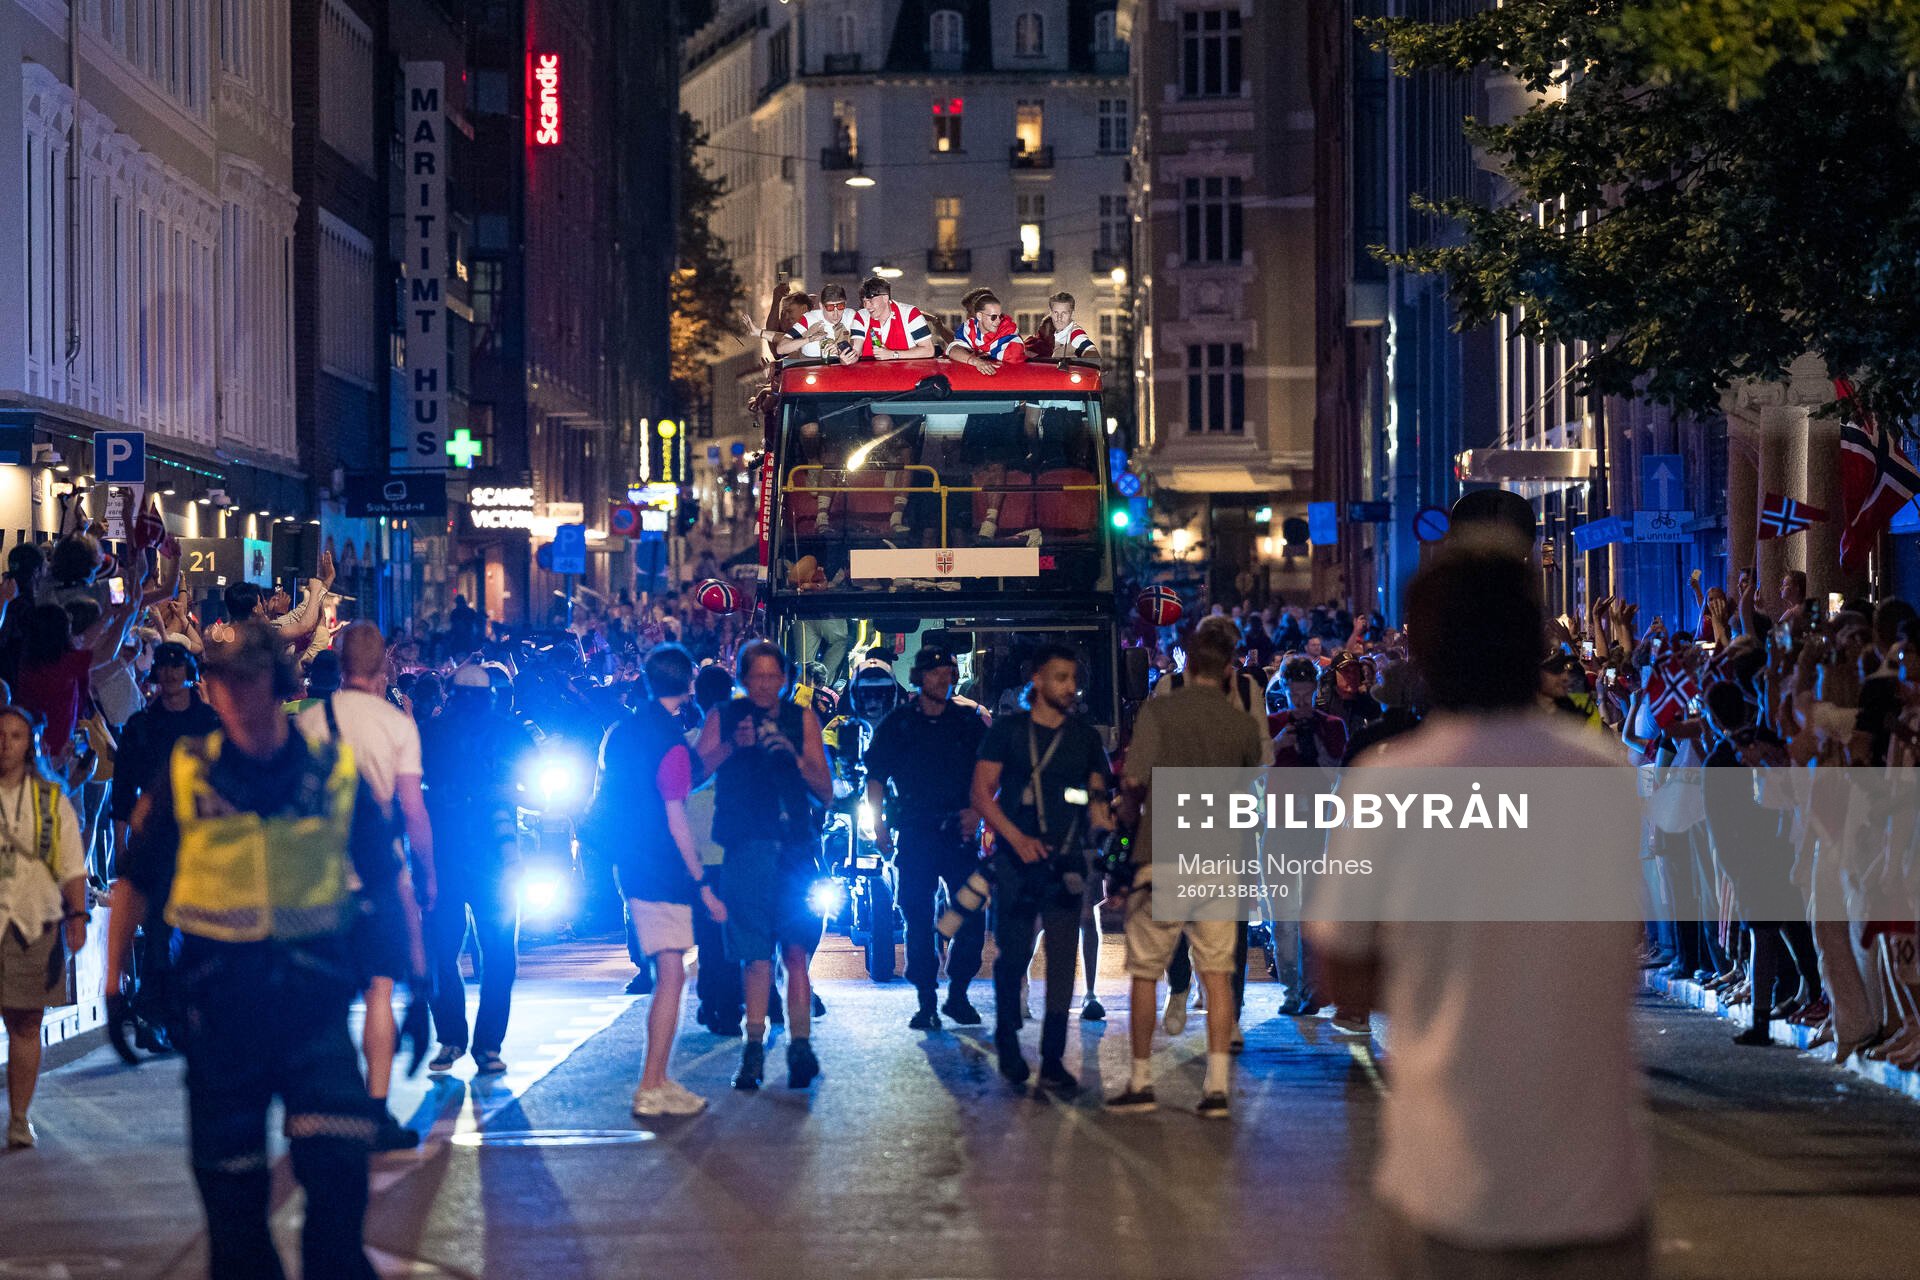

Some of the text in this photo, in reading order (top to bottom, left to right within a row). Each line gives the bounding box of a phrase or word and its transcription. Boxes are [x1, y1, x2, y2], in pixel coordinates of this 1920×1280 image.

[536, 54, 558, 144] Scandic
[411, 88, 438, 455] MARITIMT HUS
[107, 438, 132, 476] P
[561, 529, 577, 553] P
[1579, 525, 1619, 544] Taxi
[190, 551, 215, 572] 21
